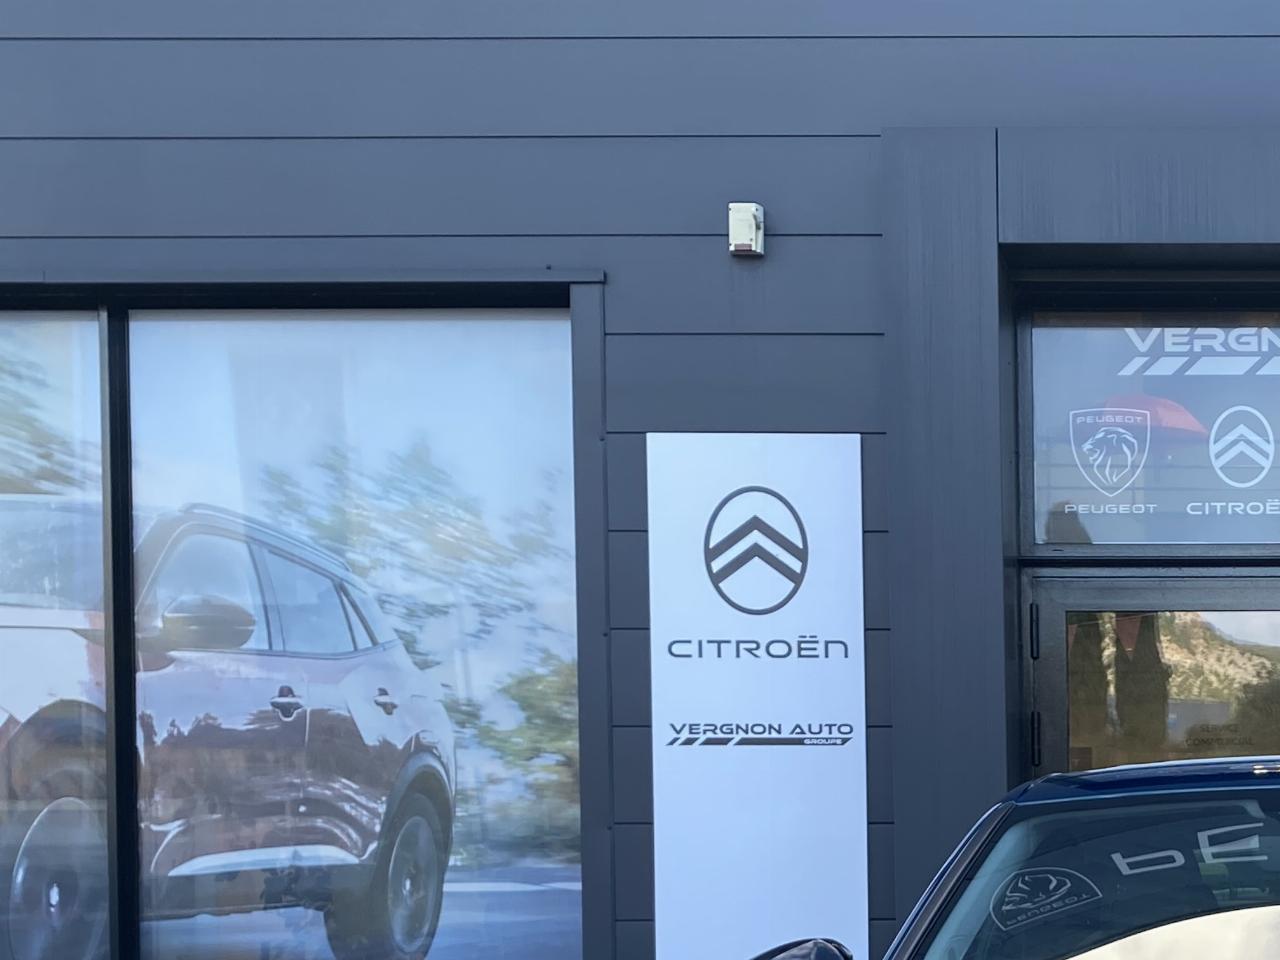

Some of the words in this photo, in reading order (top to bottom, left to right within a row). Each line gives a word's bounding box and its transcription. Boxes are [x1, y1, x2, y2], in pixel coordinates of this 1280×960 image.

[1075, 414, 1144, 425] PEUGEOT
[1064, 503, 1158, 515] PEUGEOT
[669, 723, 782, 736] VERGNON
[788, 723, 854, 735] AUTO
